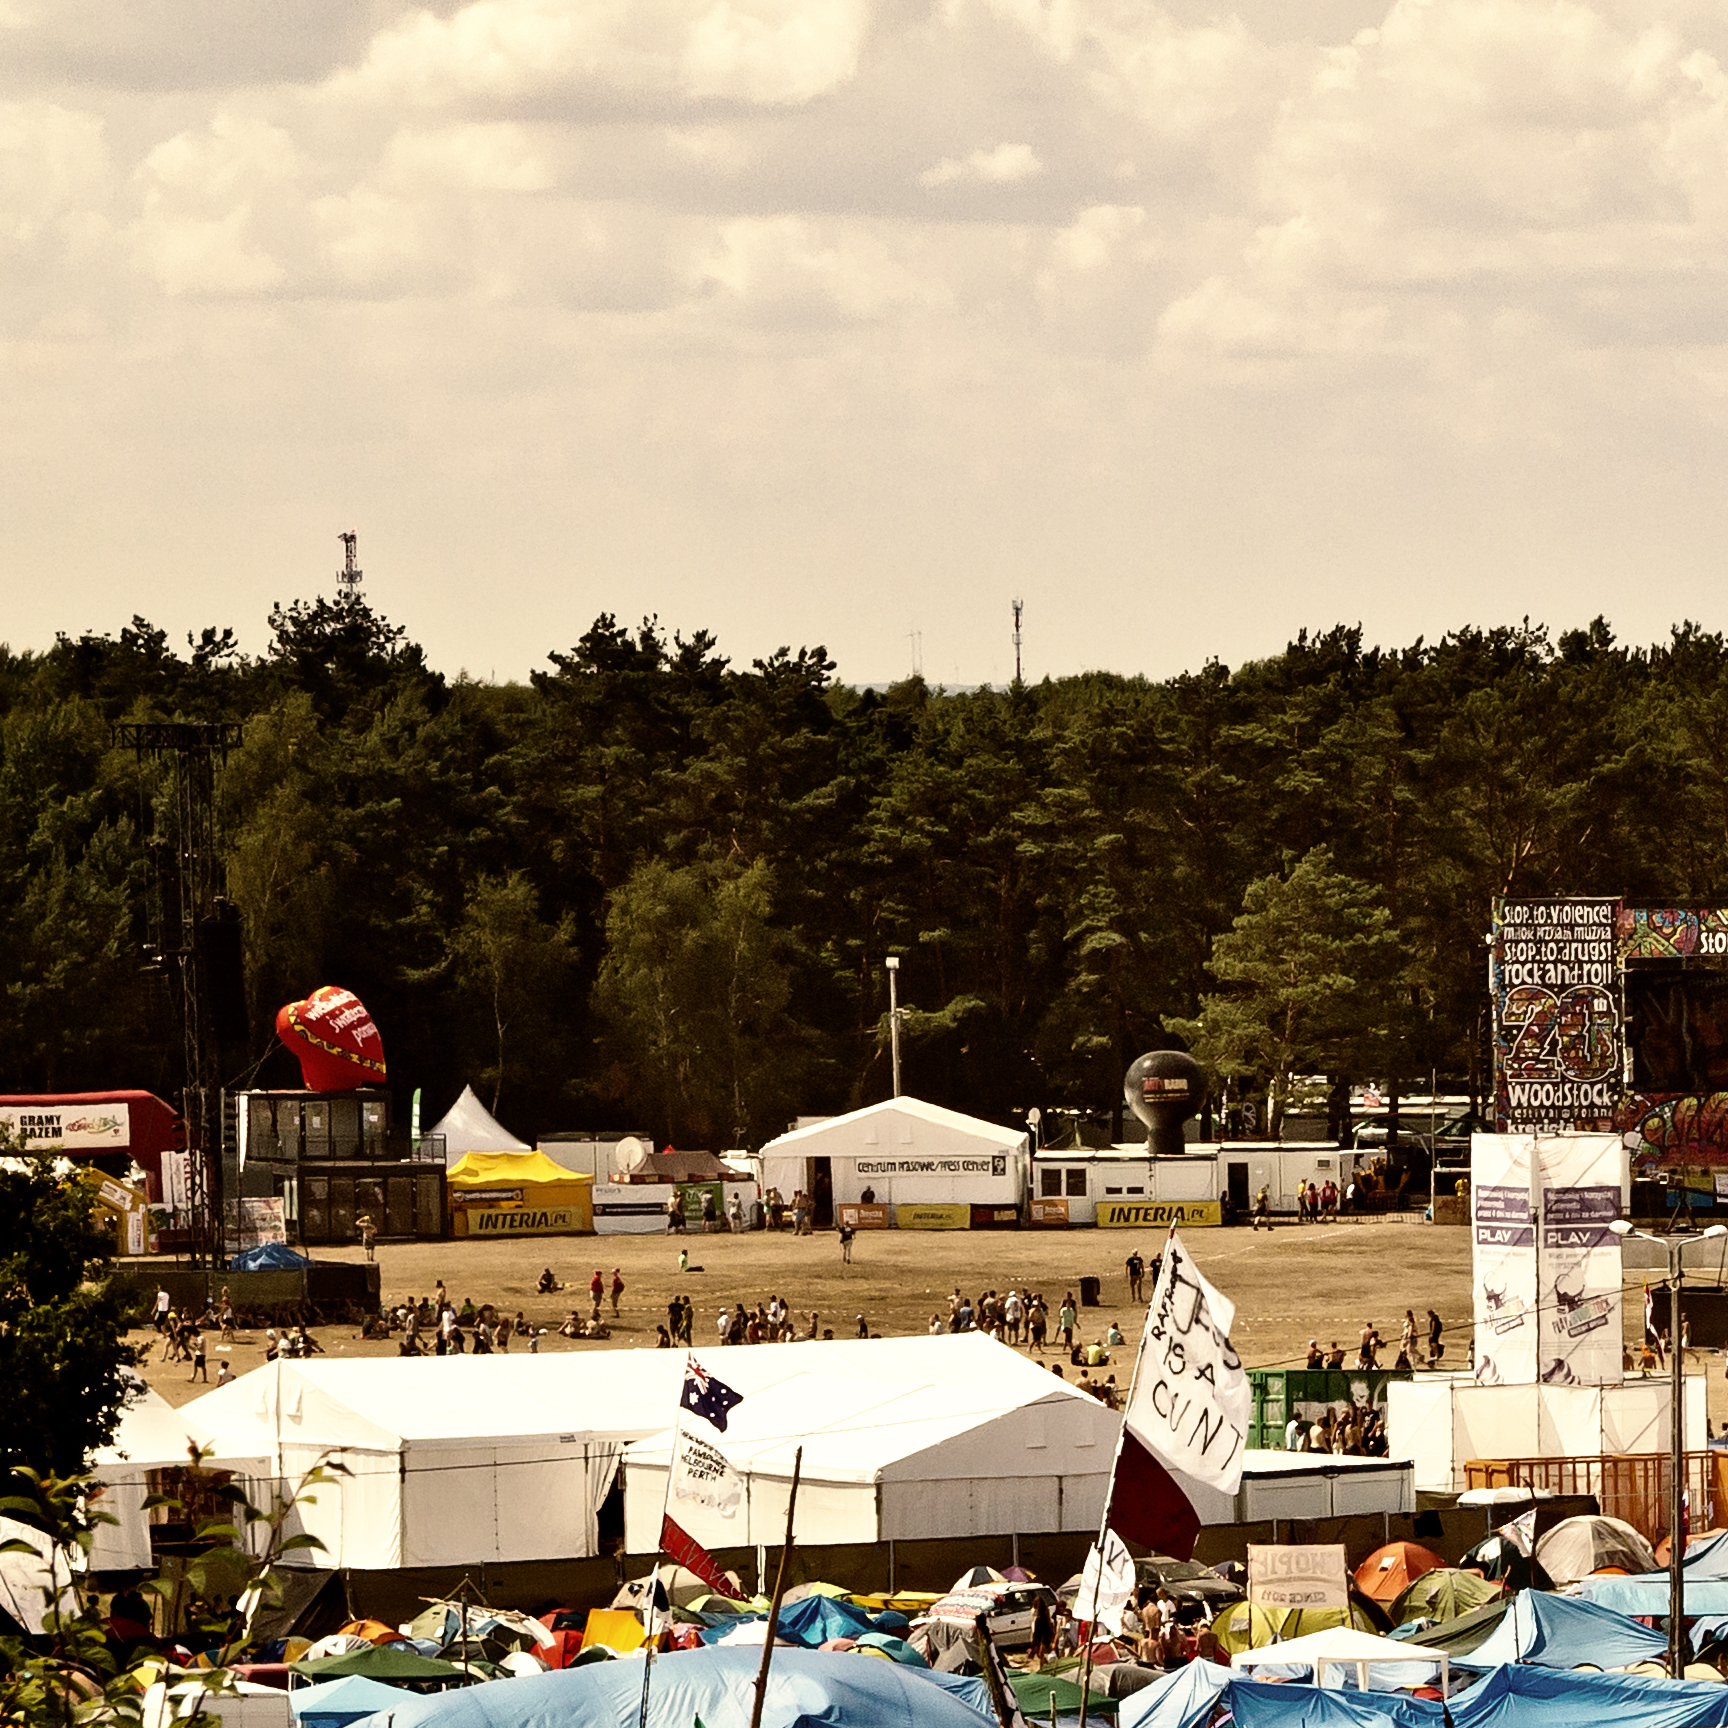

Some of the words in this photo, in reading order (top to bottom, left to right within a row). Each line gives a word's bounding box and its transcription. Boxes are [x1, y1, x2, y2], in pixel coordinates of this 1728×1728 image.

[20, 1114, 61, 1126] GRAMY
[478, 1211, 571, 1230] INTERIA.PL
[1109, 1206, 1206, 1223] INTERIA.PL
[1478, 1228, 1512, 1243] PLAY
[1547, 1230, 1591, 1245] PLAY
[1153, 1379, 1244, 1471] CUNT
[687, 1468, 718, 1483] PERTH
